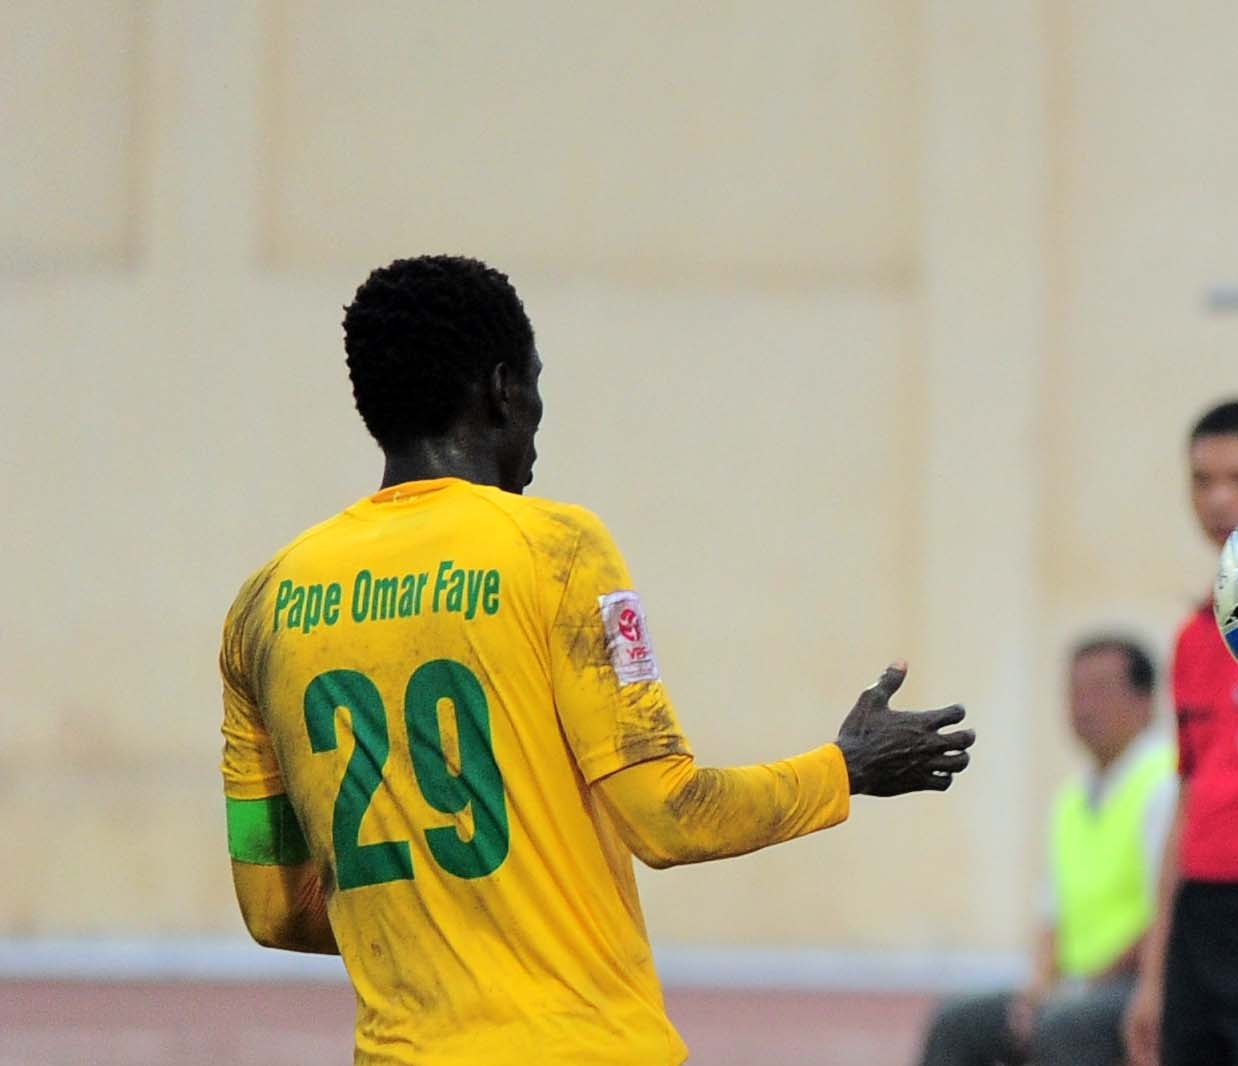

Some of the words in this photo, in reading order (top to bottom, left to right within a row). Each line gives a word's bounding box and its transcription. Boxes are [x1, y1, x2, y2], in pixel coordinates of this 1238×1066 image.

[273, 579, 342, 634] Pape
[351, 569, 428, 623] Omar
[432, 560, 500, 620] Faye
[303, 658, 510, 891] 29
